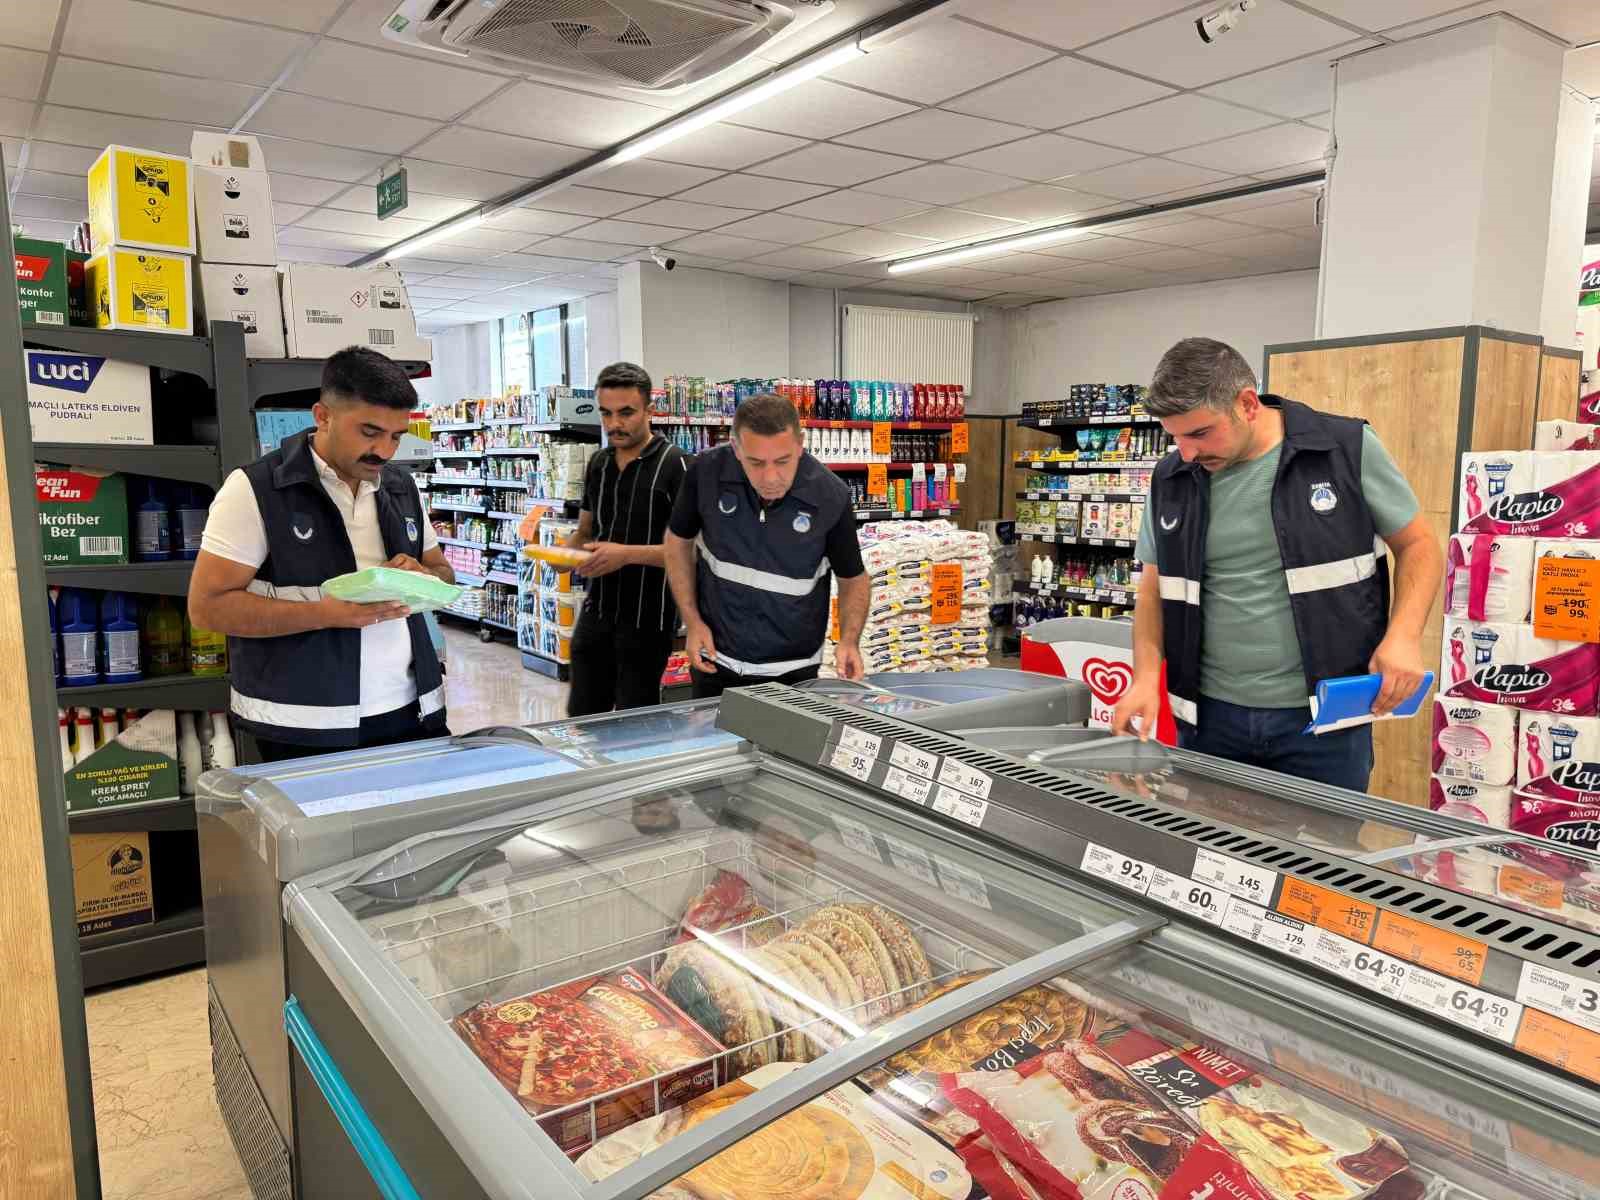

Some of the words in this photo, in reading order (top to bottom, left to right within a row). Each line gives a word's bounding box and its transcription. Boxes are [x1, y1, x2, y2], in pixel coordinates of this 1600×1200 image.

[20, 288, 54, 298] Konfor
[61, 401, 99, 412] LATEKS
[50, 411, 92, 420] PUDRALI
[1497, 493, 1558, 521] Papia
[39, 512, 100, 525] ikrofiber
[50, 526, 77, 538] Bez
[1511, 521, 1541, 536] Inova
[1569, 608, 1585, 618] 99
[1480, 664, 1545, 692] Papia
[1497, 693, 1528, 705] Inova
[851, 756, 865, 770] 95
[91, 785, 119, 797] KREM
[121, 780, 151, 792] SPREY
[97, 795, 116, 804] ÇOK
[116, 790, 147, 801] AMAÇLI
[1121, 860, 1143, 881] 92
[1238, 874, 1261, 891] 145
[1188, 887, 1212, 908] 60
[1285, 933, 1303, 946] 179
[1458, 959, 1474, 971] 65
